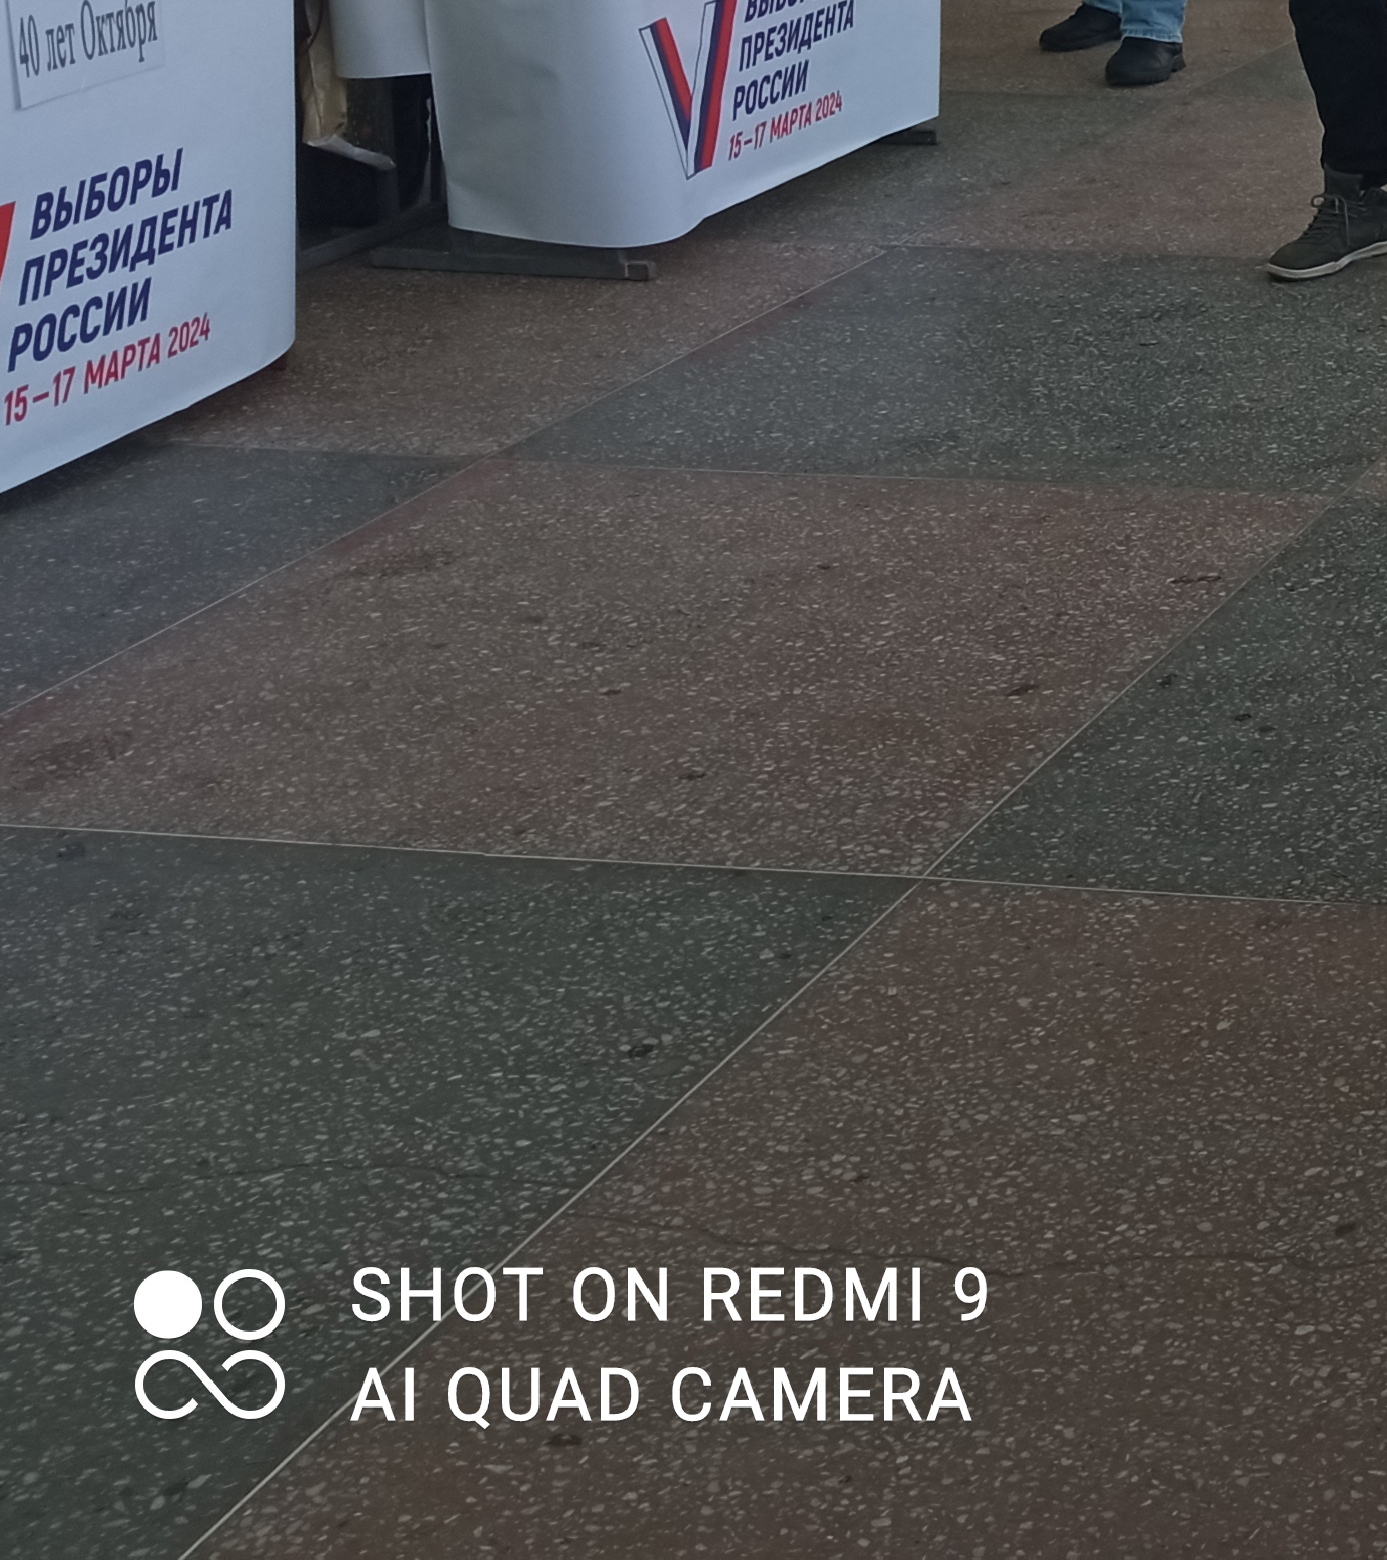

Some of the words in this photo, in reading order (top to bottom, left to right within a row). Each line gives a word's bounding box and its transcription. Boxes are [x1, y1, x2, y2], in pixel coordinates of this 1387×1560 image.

[17, 13, 41, 79] 40
[45, 22, 76, 72] лет
[732, 59, 810, 122] РОССИИ
[769, 102, 813, 144] МАРТА
[815, 90, 844, 123] 2024
[30, 147, 184, 241] ВЫБОРЫ
[18, 188, 234, 307] ПРЕЗИДЕНТА
[7, 276, 153, 373] РОССИИ
[82, 338, 162, 395] МАРТА
[166, 312, 212, 361] 2024
